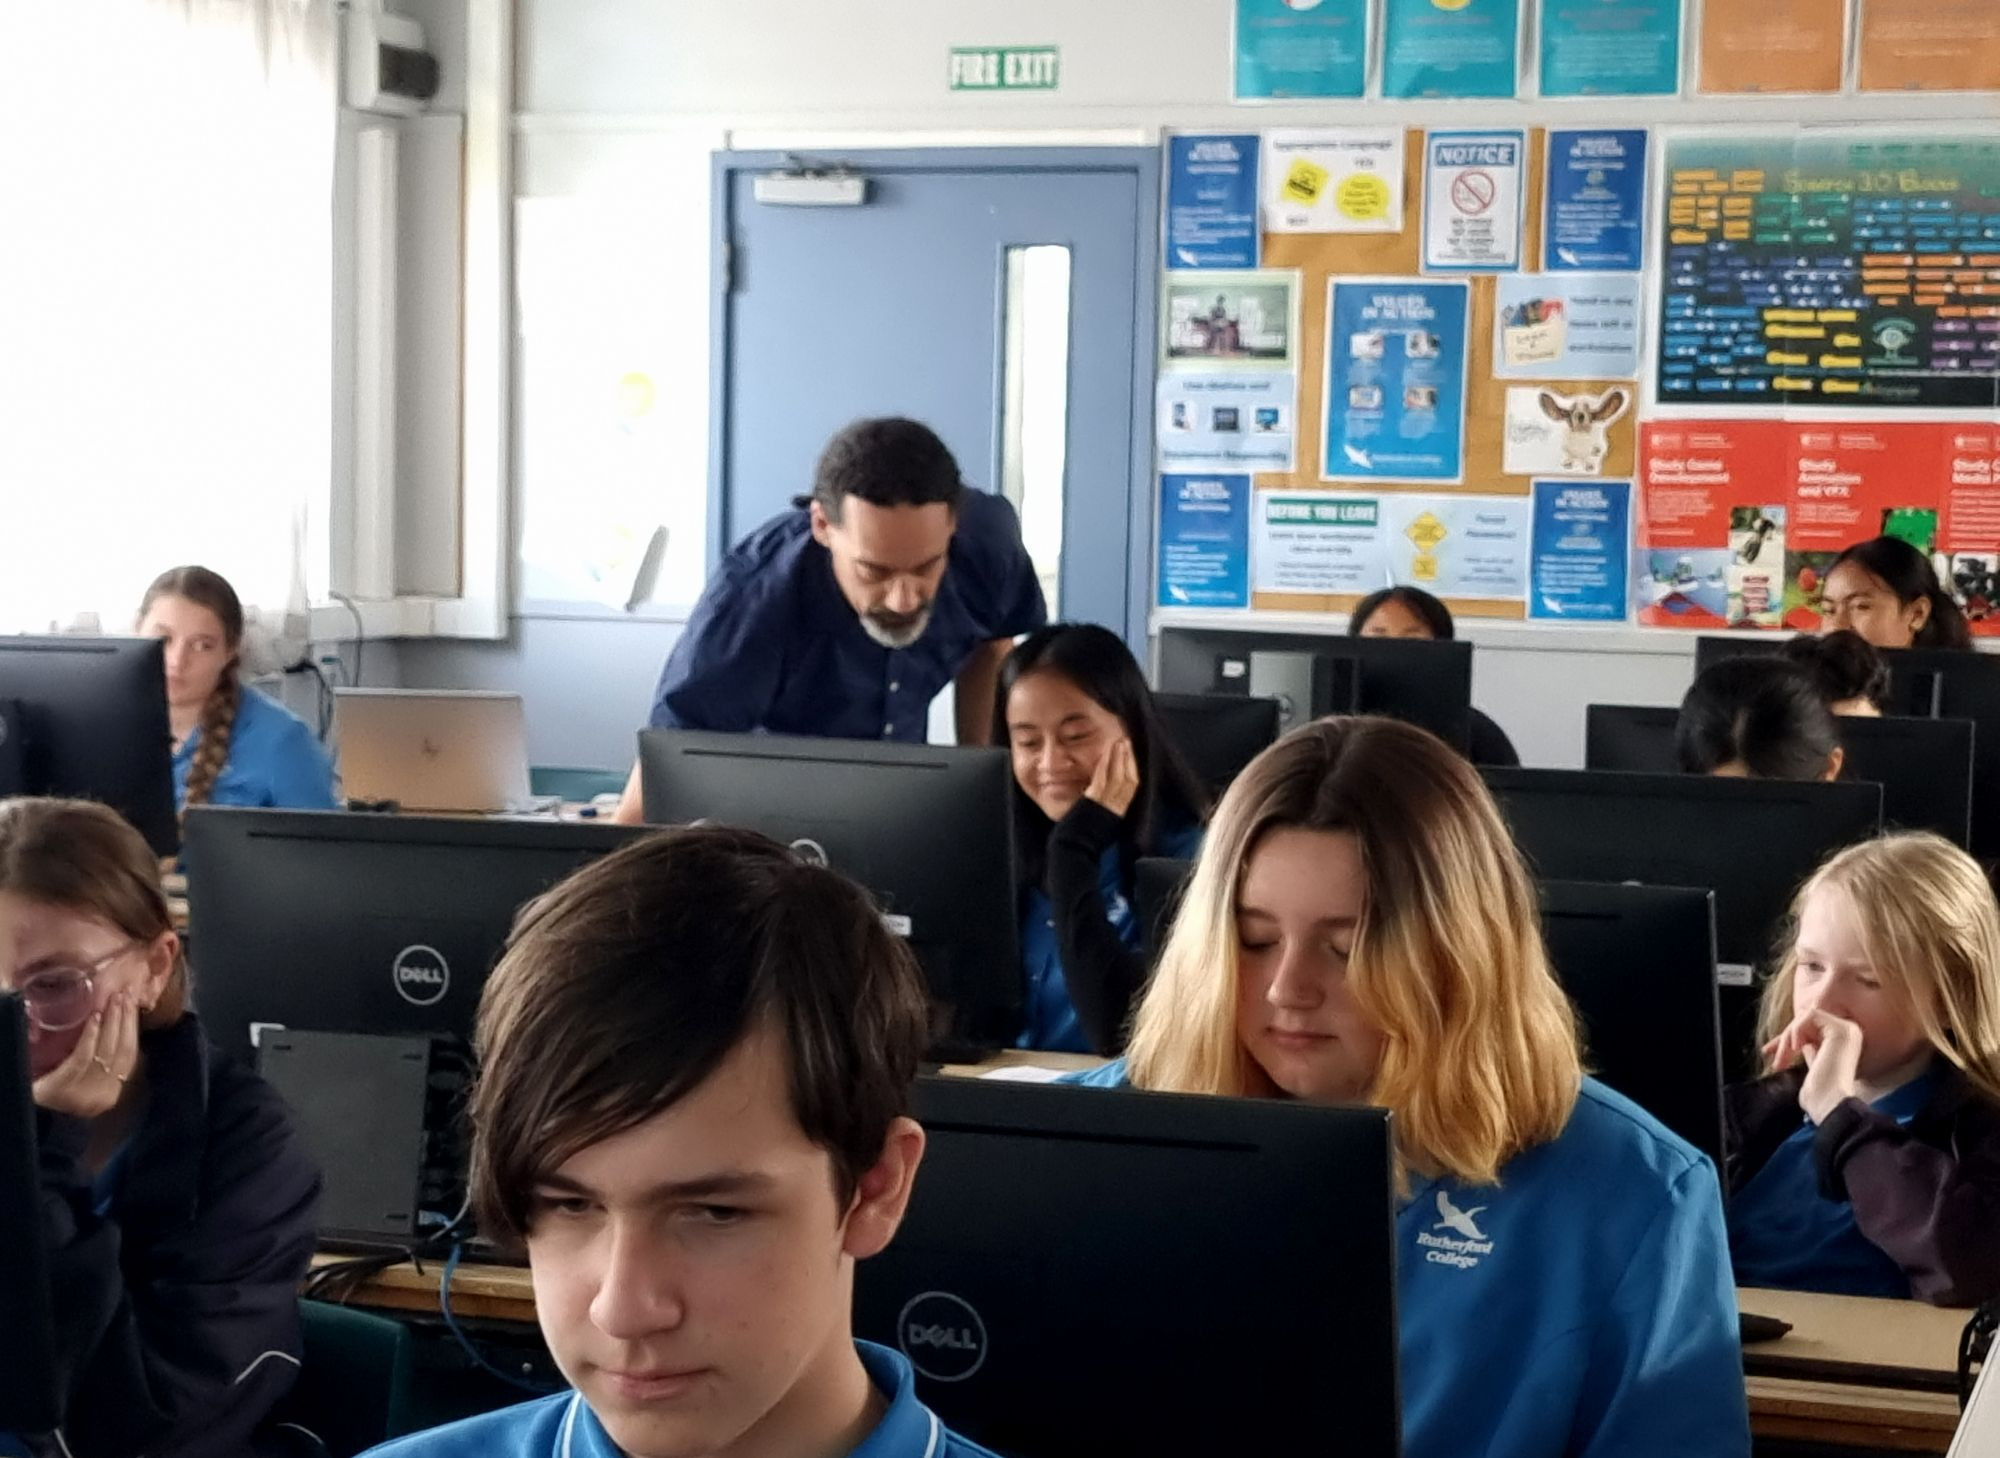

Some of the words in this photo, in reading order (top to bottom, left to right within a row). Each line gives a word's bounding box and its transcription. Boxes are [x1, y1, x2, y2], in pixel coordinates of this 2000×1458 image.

[1003, 51, 1056, 86] EXIT
[1437, 145, 1513, 165] NOTICE
[399, 965, 442, 984] DELL
[1416, 1232, 1494, 1255] Rutherford
[1426, 1250, 1478, 1269] College
[908, 1322, 977, 1350] DELL
